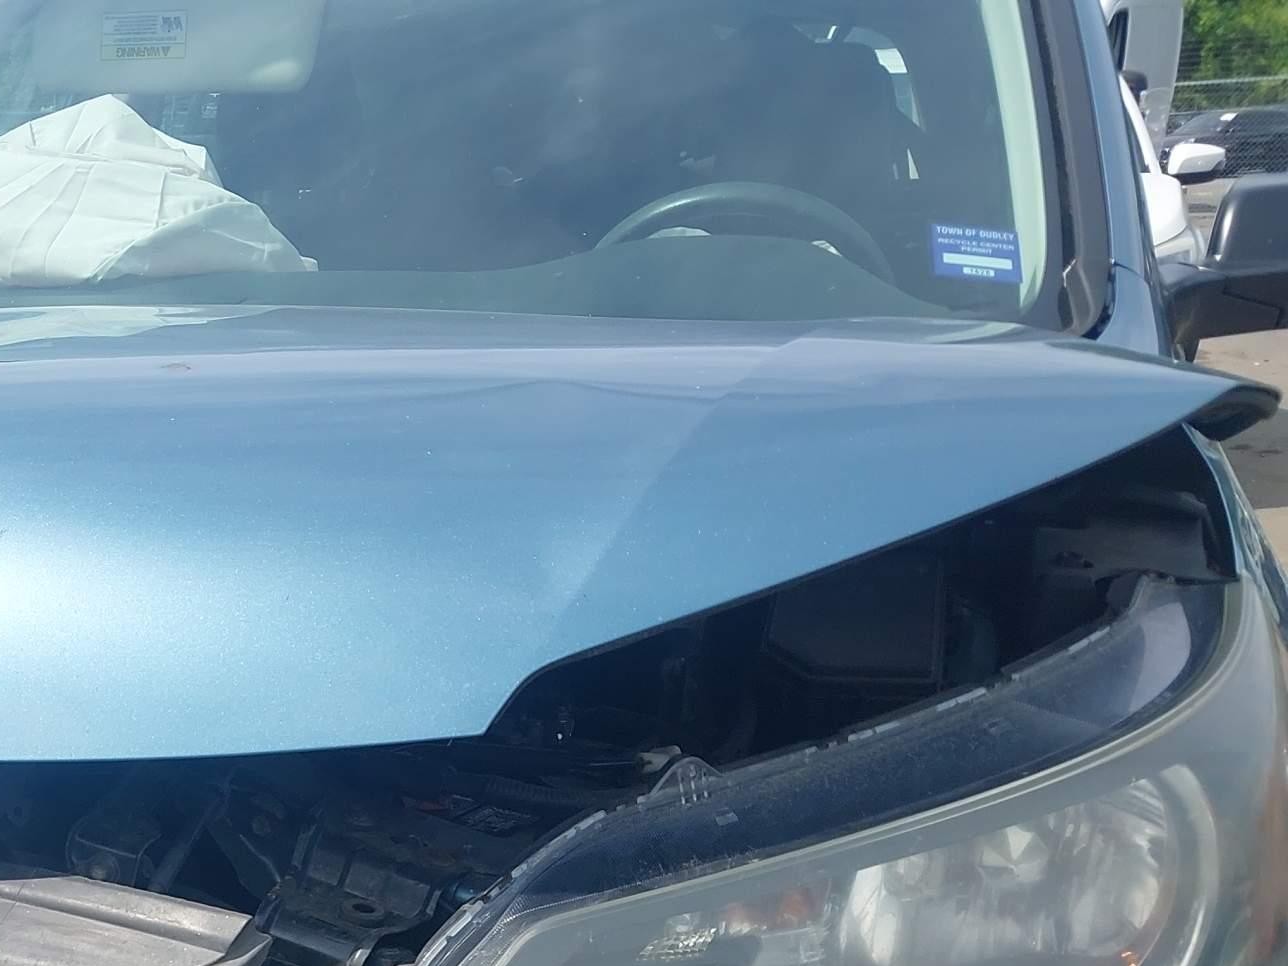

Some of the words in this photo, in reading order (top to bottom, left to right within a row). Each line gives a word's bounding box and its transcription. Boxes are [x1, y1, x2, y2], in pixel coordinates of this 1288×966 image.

[116, 46, 160, 57] WARNING
[936, 225, 963, 235] TOWN
[965, 229, 976, 237] OF
[979, 230, 1014, 240] DUDLEY
[938, 238, 978, 246] RECYCLE
[979, 241, 1015, 251] CENTER
[961, 246, 992, 255] PERMIT
